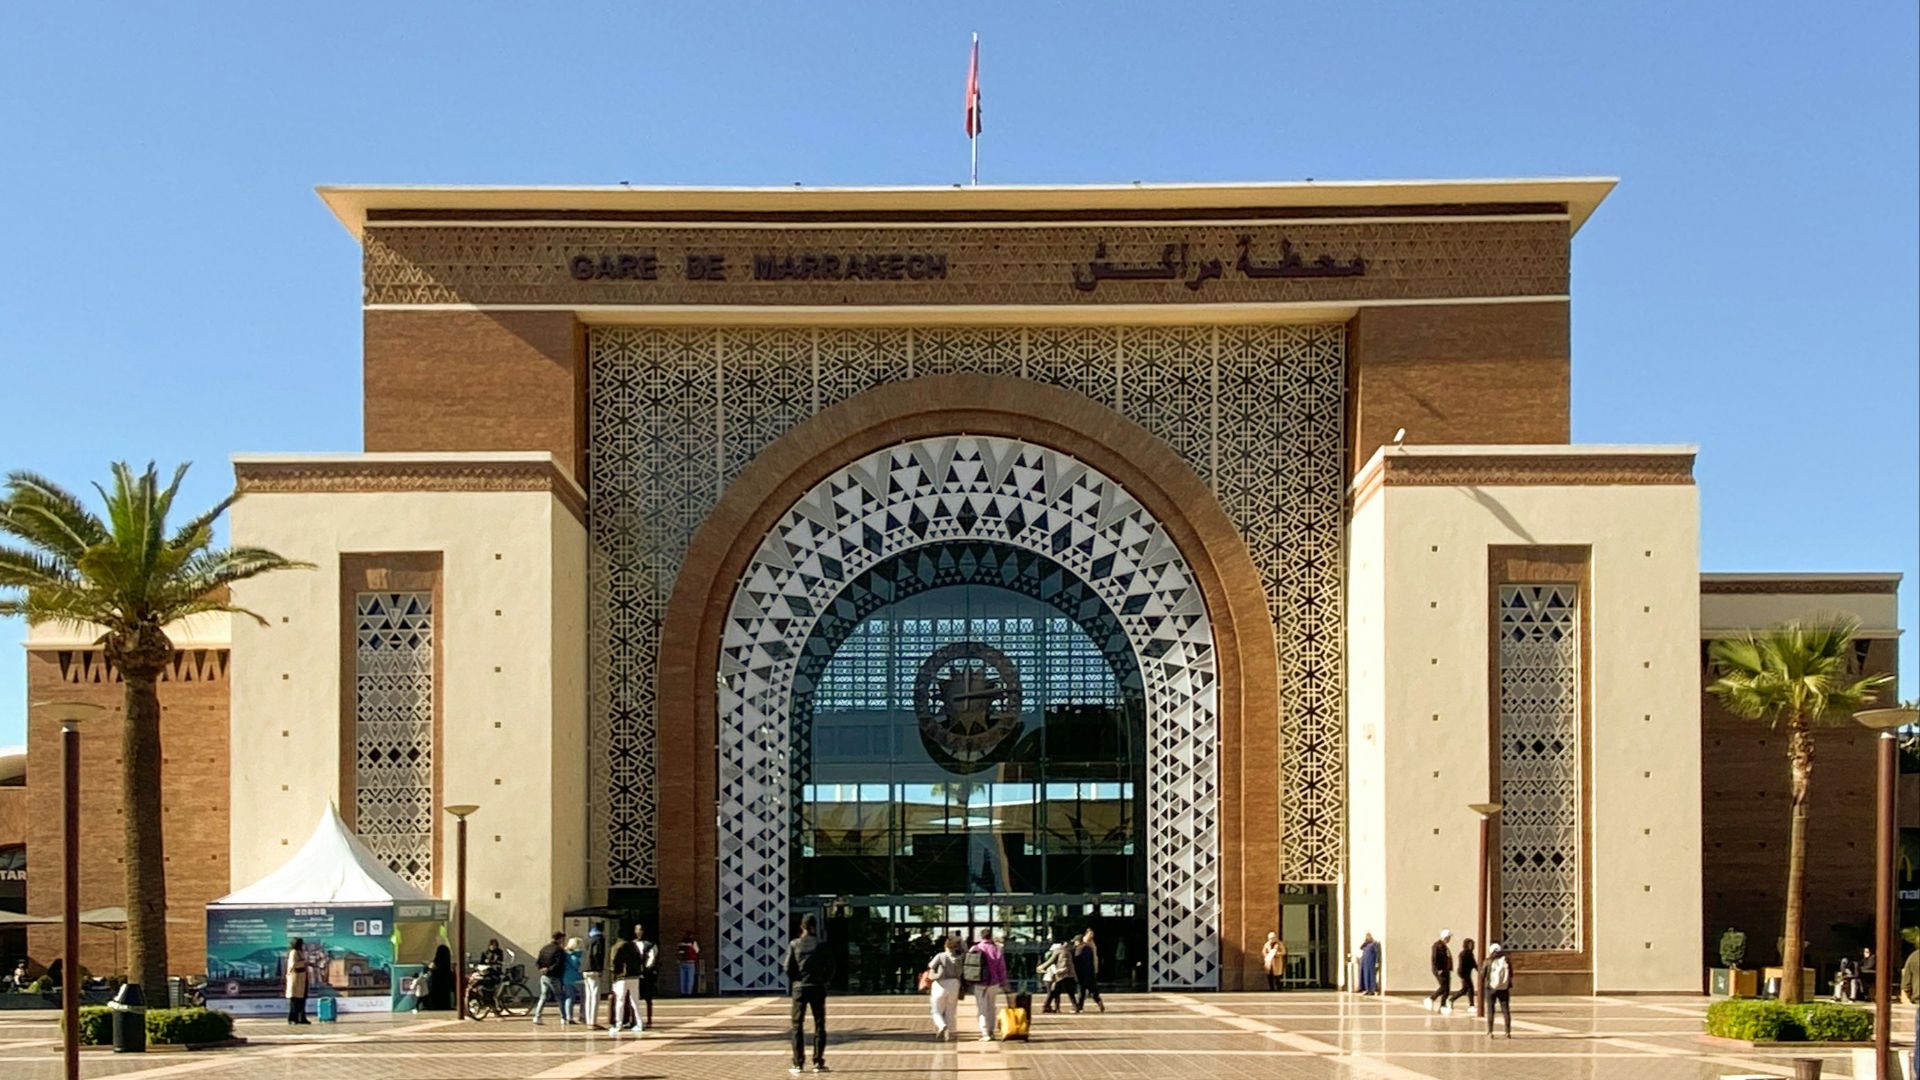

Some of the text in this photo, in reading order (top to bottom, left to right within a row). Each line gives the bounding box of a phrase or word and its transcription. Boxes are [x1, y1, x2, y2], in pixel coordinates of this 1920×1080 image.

[572, 255, 947, 281] GARE DE MARRAKECH
